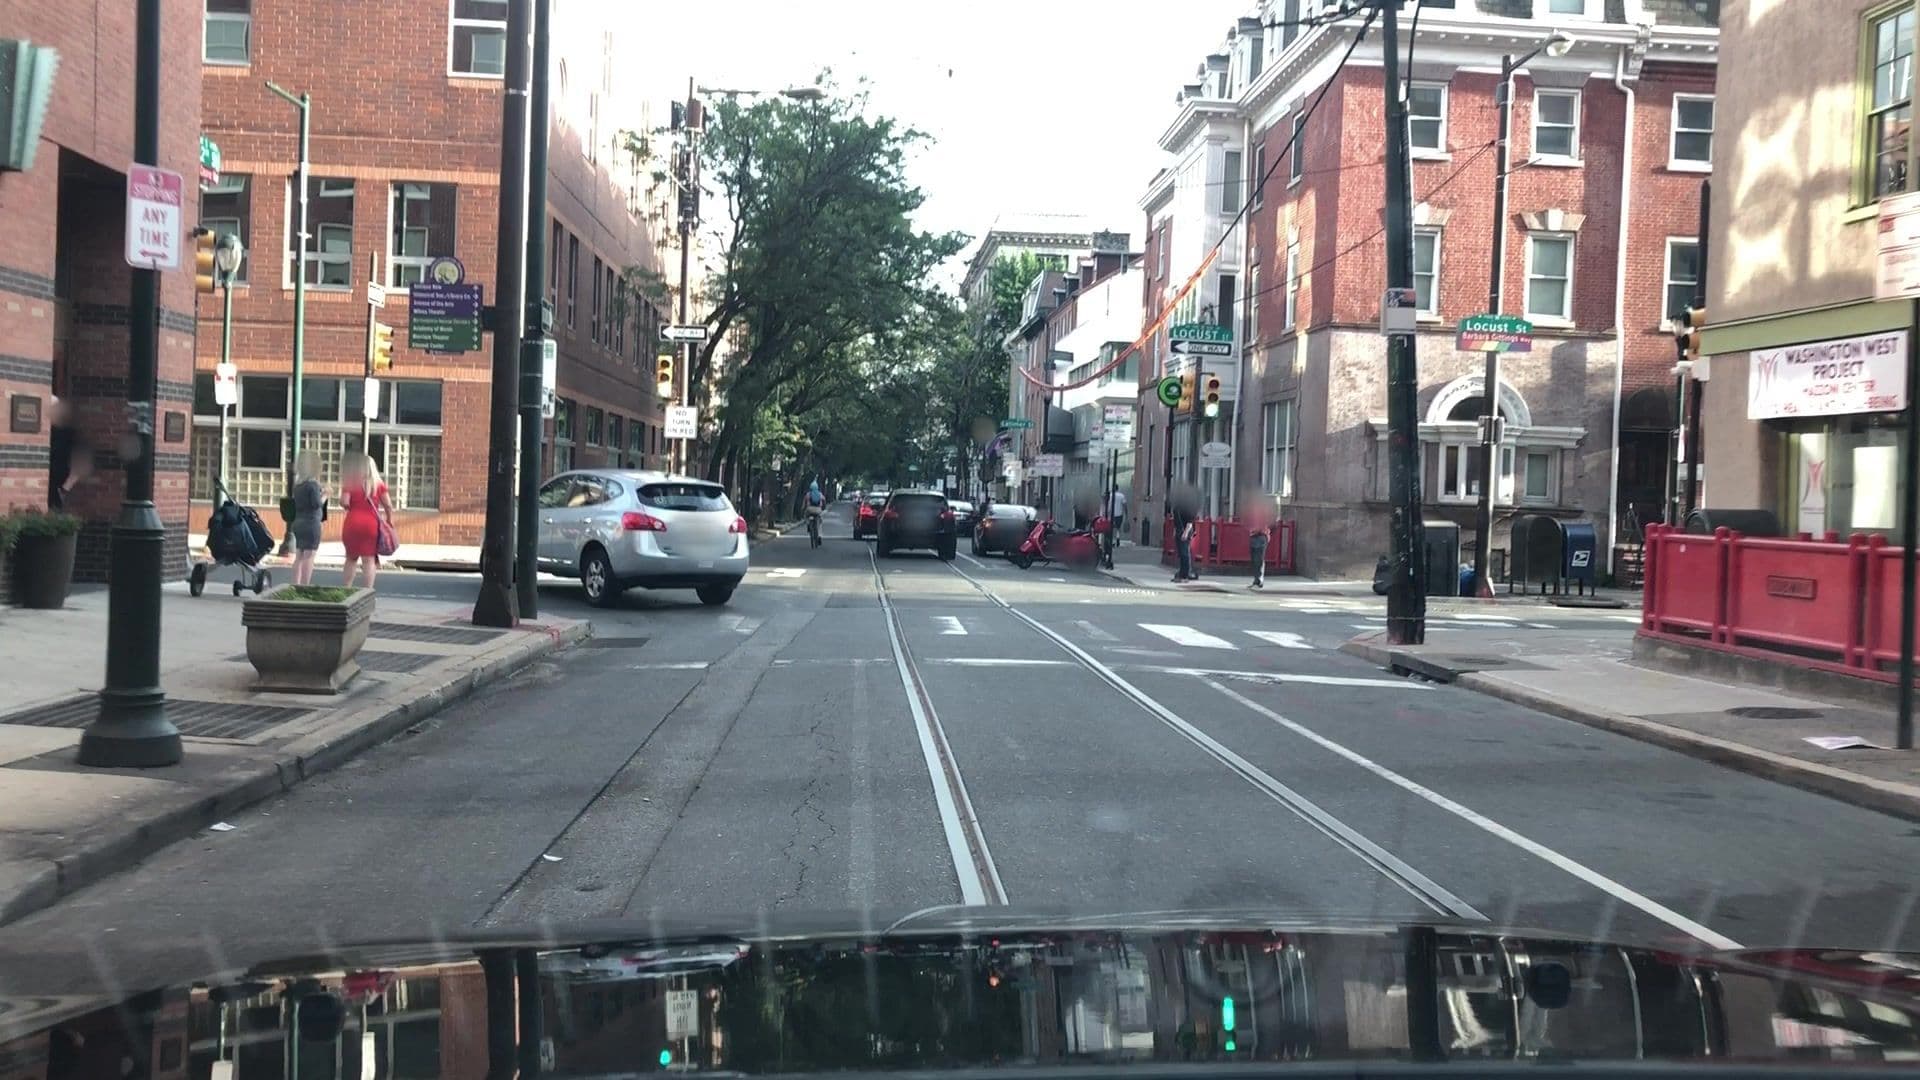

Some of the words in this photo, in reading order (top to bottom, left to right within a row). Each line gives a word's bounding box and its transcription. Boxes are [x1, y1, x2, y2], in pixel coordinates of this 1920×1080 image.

[143, 206, 168, 224] ANY
[139, 227, 170, 249] TIME
[1173, 328, 1218, 340] LOCUST
[1466, 320, 1508, 332] Locust
[1515, 324, 1527, 334] St
[1462, 331, 1490, 340] Barbara
[1491, 333, 1519, 342] Gittings
[1188, 344, 1201, 352] ONE
[1207, 345, 1225, 353] WAY
[1785, 341, 1862, 364] WASHINGTON
[1864, 337, 1899, 356] WEST
[1812, 360, 1864, 379] PROJECT
